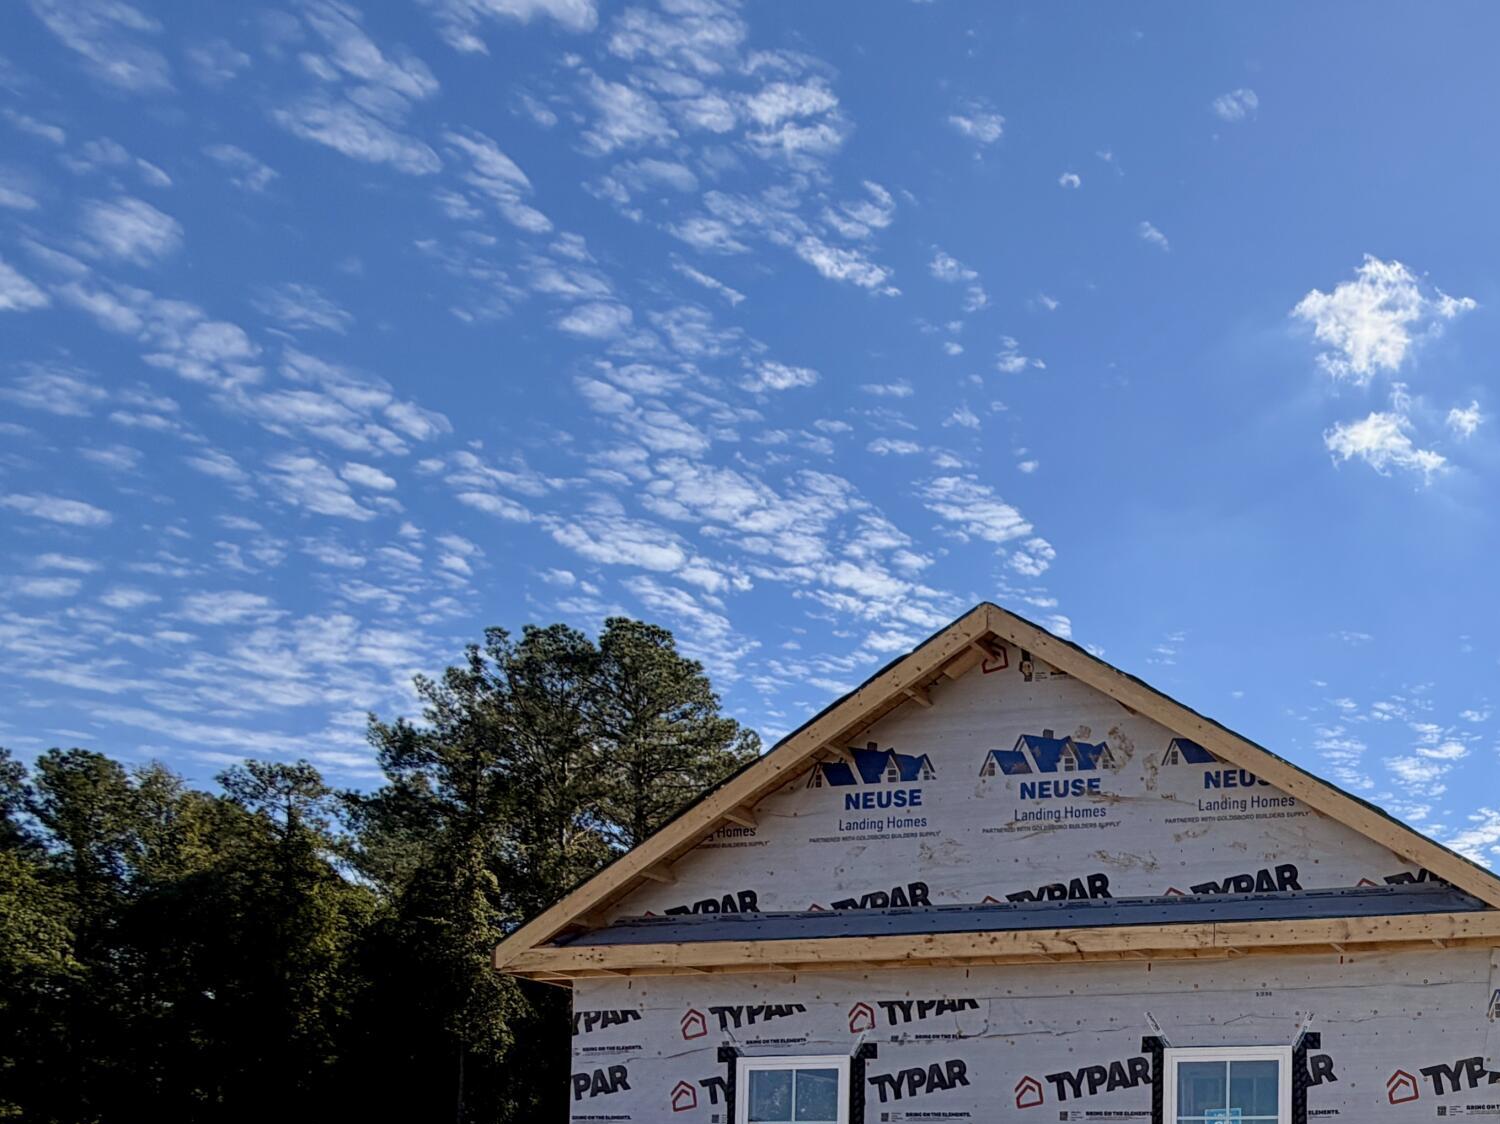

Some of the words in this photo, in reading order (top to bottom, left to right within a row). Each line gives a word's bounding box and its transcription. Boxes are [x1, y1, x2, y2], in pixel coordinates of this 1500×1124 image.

[845, 789, 922, 811] NEUSE
[1020, 778, 1101, 800] NEUSE
[1014, 808, 1060, 823] Landing
[1065, 806, 1106, 818] Homes
[1198, 798, 1247, 812] Landing
[1251, 795, 1295, 809] Homes
[839, 818, 883, 832] Landing
[887, 816, 927, 828] Homes
[664, 890, 760, 915] YPAR
[868, 1059, 970, 1103] TYPAR
[1045, 1056, 1152, 1101] TYPAR
